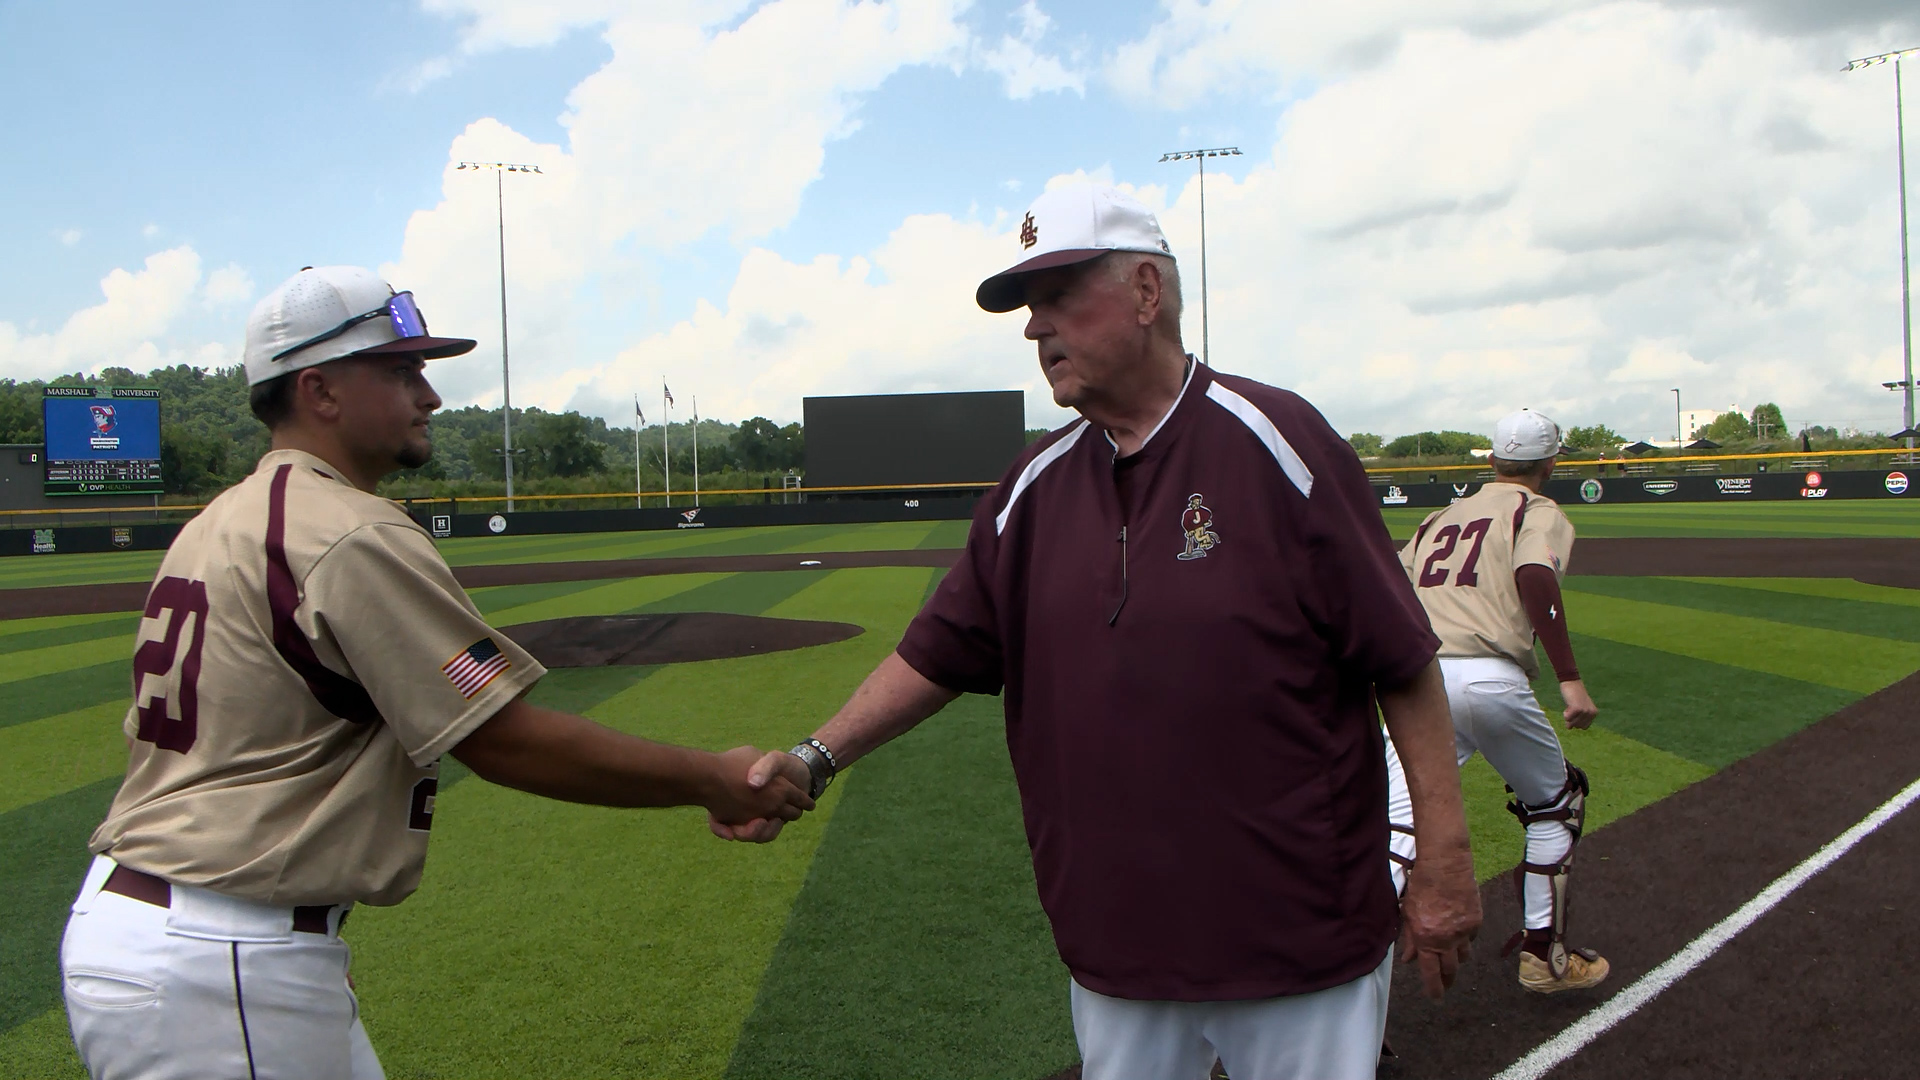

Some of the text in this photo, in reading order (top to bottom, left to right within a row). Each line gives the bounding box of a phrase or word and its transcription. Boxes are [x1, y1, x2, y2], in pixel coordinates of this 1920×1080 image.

[115, 389, 160, 397] UNIVERSITY
[904, 499, 919, 508] 400
[1192, 510, 1201, 524] J
[1418, 517, 1494, 588] 27
[134, 576, 209, 756] 20
